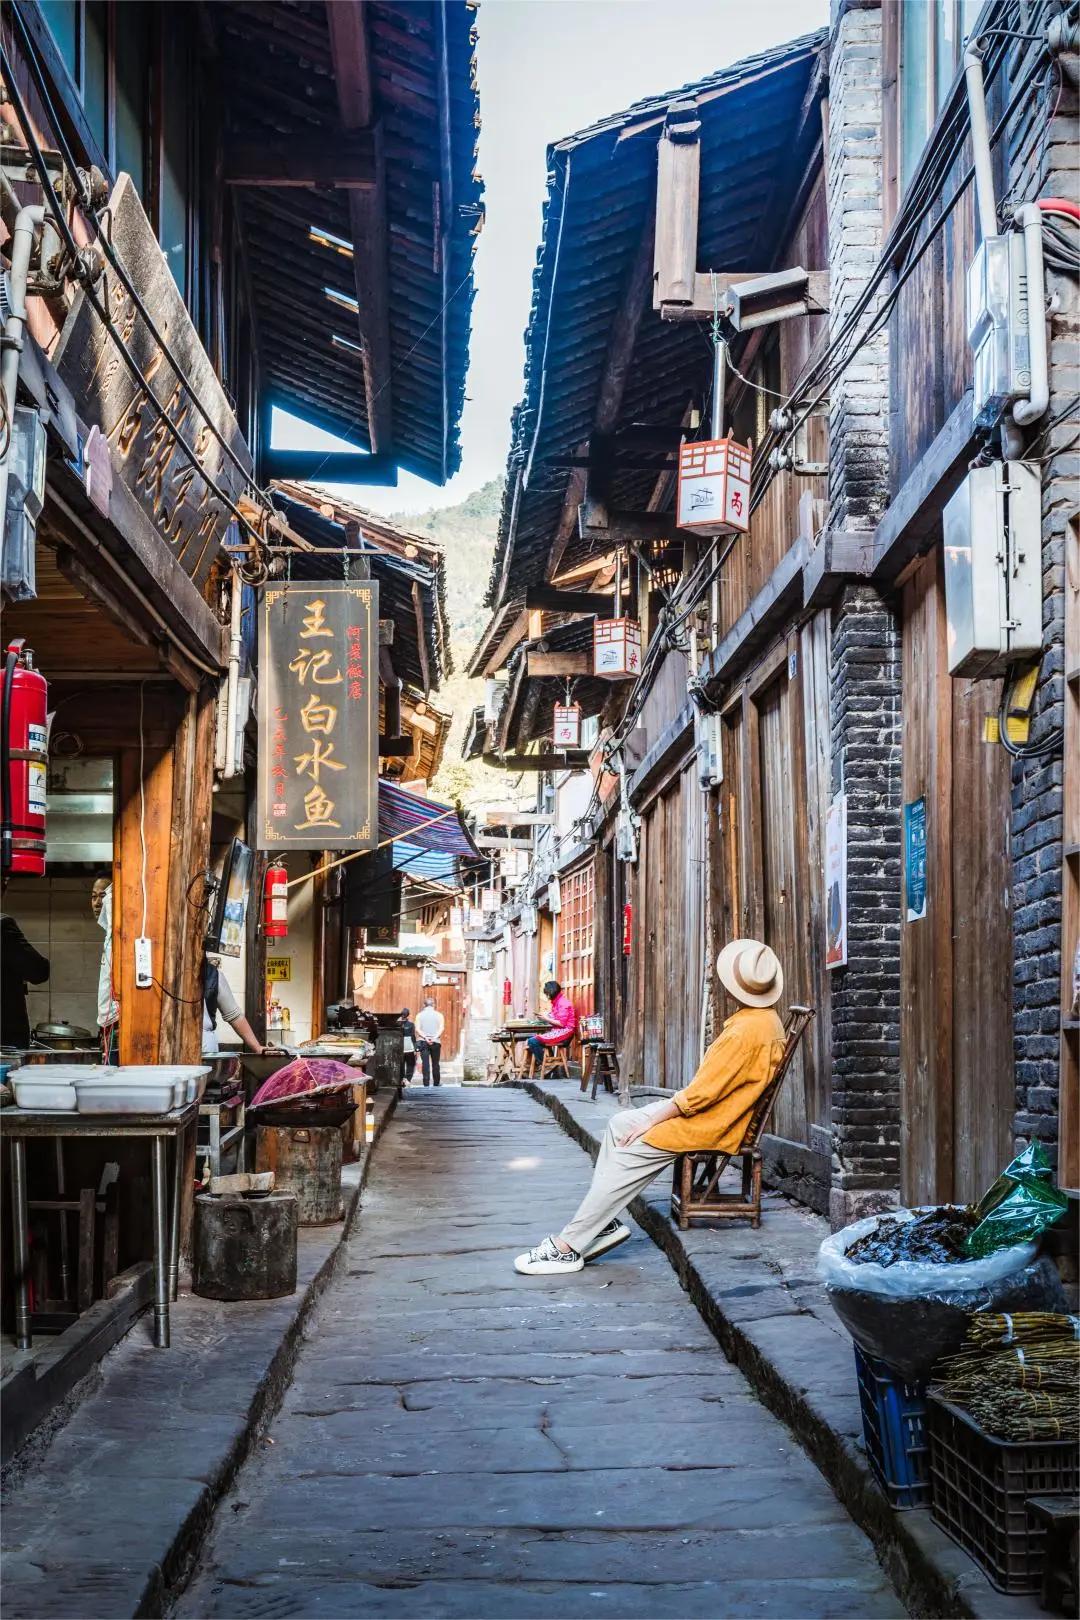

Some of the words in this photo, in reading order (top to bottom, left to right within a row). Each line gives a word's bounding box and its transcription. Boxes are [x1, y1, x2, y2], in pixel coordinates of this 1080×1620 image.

[731, 491, 743, 517] 丙
[288, 599, 347, 830] 王记白水鱼
